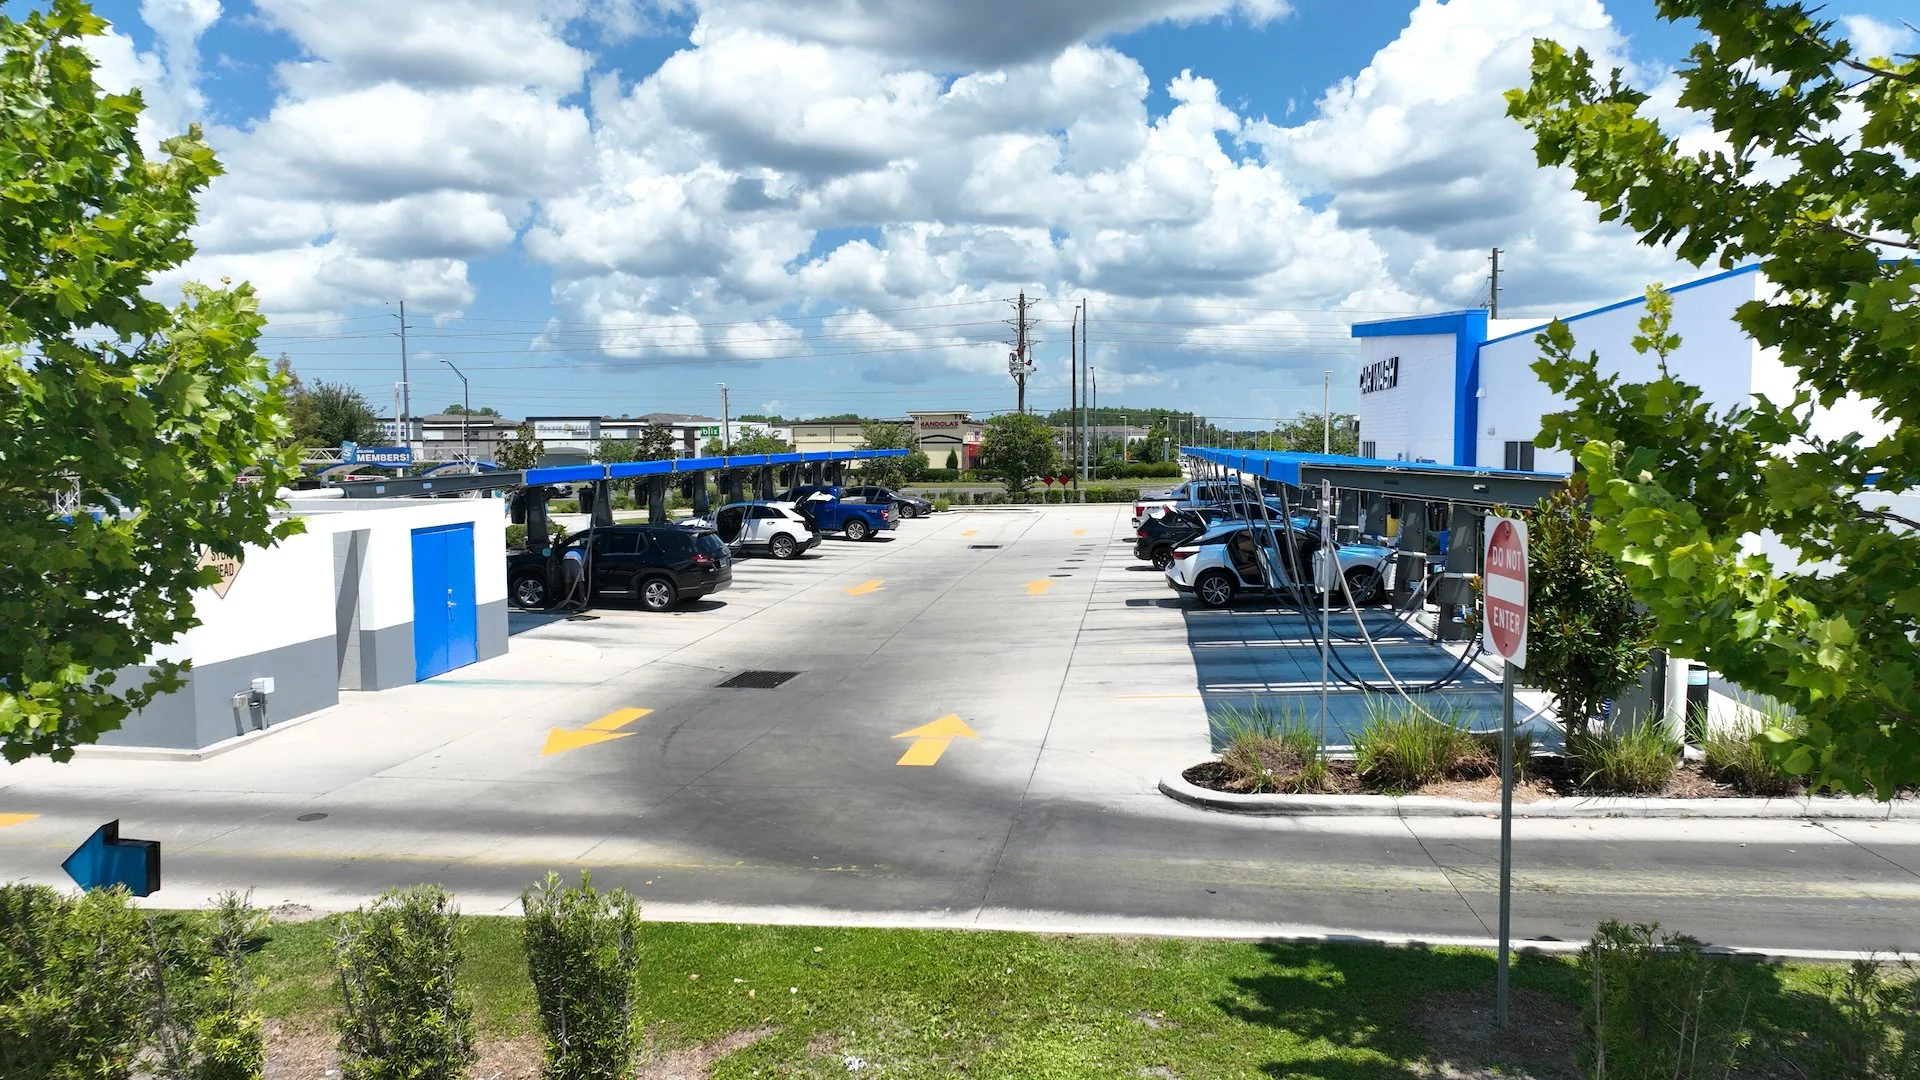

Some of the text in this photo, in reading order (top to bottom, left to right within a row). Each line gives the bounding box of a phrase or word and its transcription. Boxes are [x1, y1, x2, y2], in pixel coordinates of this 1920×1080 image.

[1359, 357, 1398, 393] CAR WASH
[356, 453, 410, 462] MEMBERS!
[1492, 545, 1522, 572] DO NOT
[1493, 606, 1521, 634] ENTER
